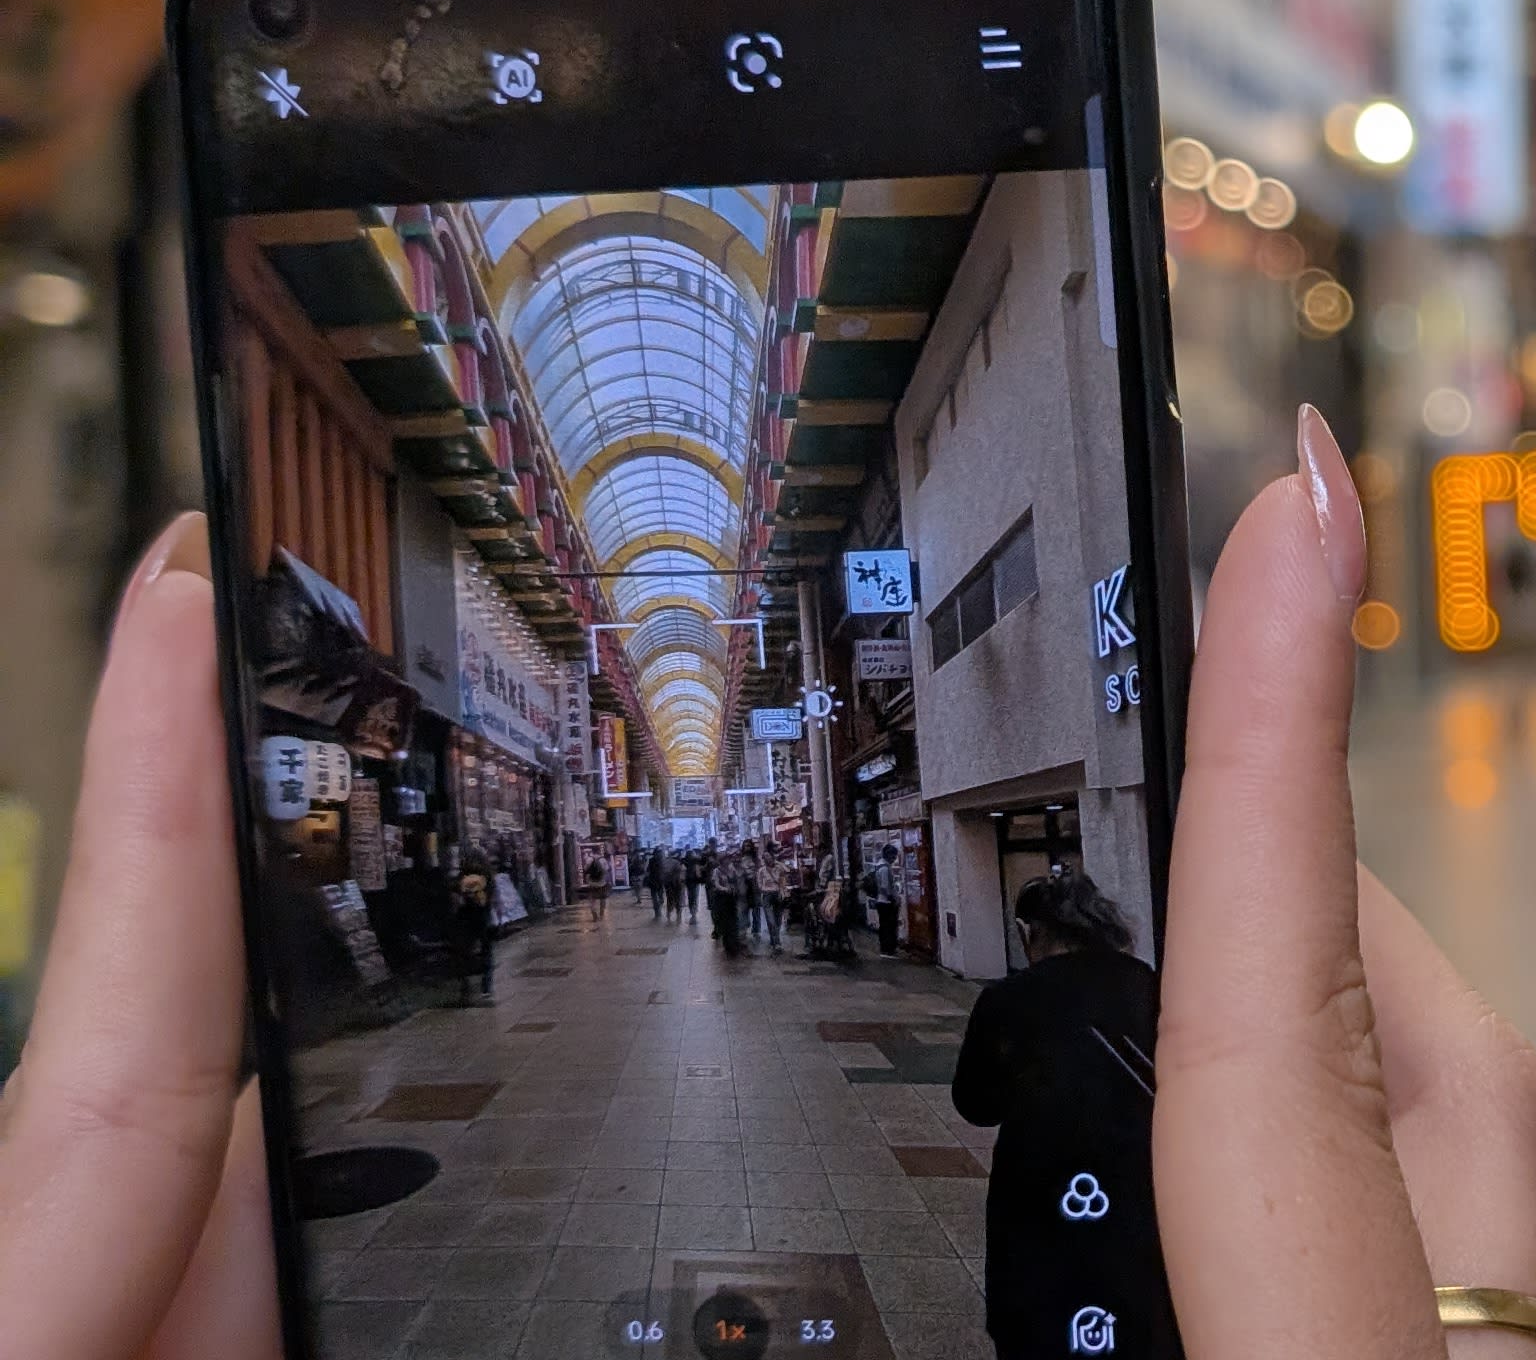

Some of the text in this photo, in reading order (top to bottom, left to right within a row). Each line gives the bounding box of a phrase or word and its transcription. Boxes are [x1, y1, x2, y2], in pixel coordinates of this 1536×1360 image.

[506, 69, 529, 89] AI
[1094, 564, 1136, 658] K
[627, 1318, 836, 1341] 0.6 1x 3.3
